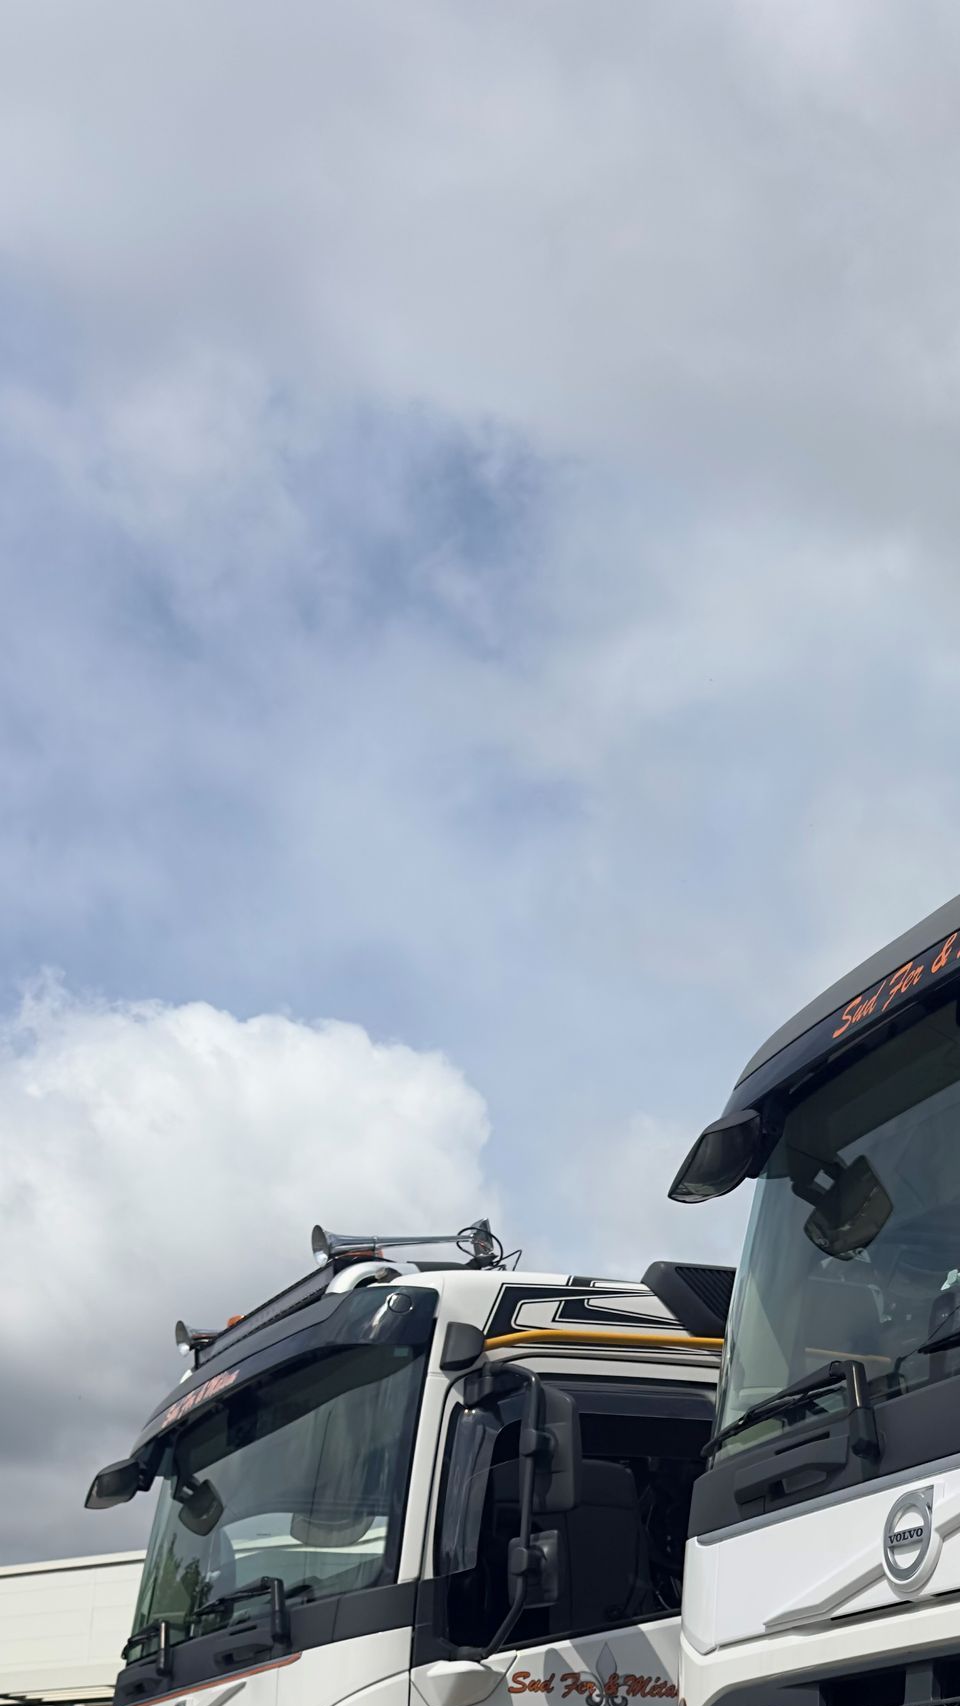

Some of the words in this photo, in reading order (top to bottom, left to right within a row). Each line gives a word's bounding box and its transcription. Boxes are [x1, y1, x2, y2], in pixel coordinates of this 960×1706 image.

[832, 980, 887, 1039] Sud
[881, 961, 924, 1012] Fer
[931, 933, 958, 974] &
[888, 1528, 923, 1544] VOLVO
[508, 1671, 556, 1695] Sud
[560, 1672, 596, 1698] Fer
[604, 1672, 619, 1695] &
